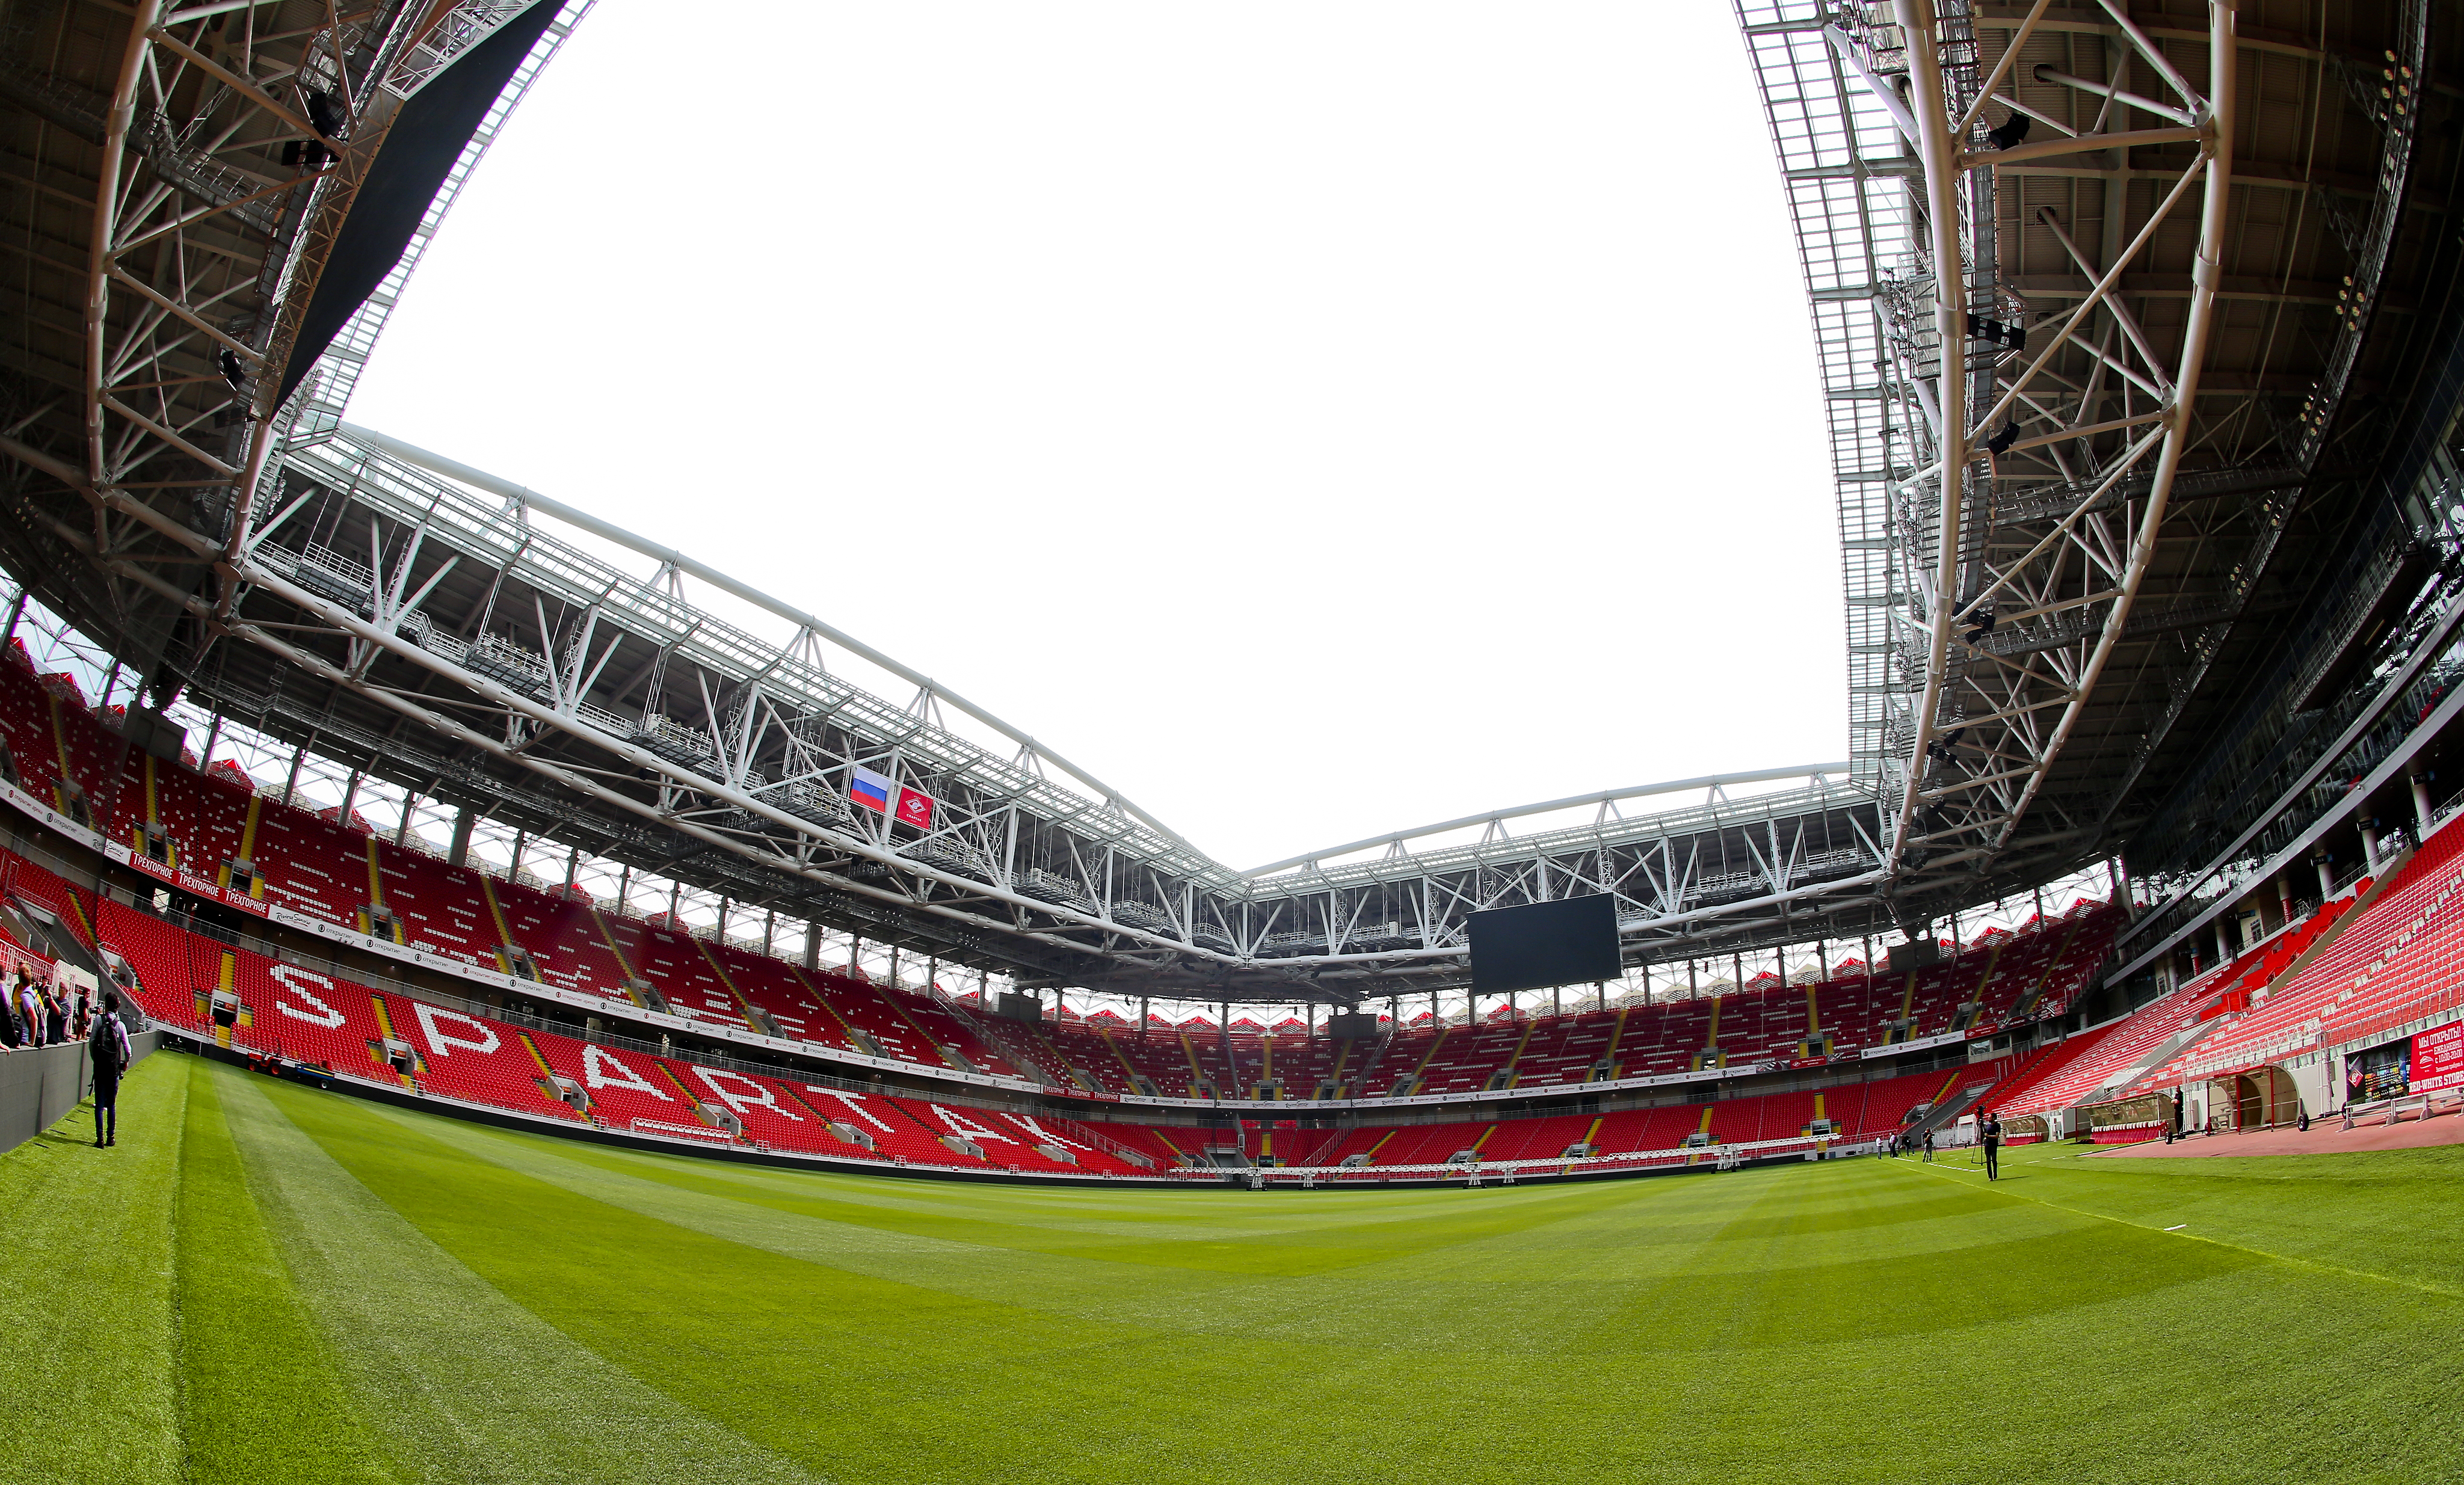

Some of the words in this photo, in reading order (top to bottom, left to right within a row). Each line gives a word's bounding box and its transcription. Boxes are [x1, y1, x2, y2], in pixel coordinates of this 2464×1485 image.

[14, 794, 32, 807] открытие
[32, 805, 43, 815] арена
[906, 813, 922, 822] СПАРТАК
[54, 818, 77, 833] открытие
[326, 928, 353, 939] открытие
[375, 943, 401, 954] открытие
[423, 957, 448, 967] открытие
[469, 970, 490, 978] открытие
[518, 982, 542, 992] открытие
[608, 1005, 631, 1014] открытие
[2418, 1036, 2429, 1049] МЫ
[2430, 1026, 2461, 1045] ОТКРЫТЫ!
[2434, 1039, 2462, 1055] ЕЖЕДНЕВНО
[2439, 1049, 2462, 1063] 10:00-20:00
[2409, 1075, 2443, 1093] RED-WHITE
[2444, 1070, 2464, 1085] STORE
